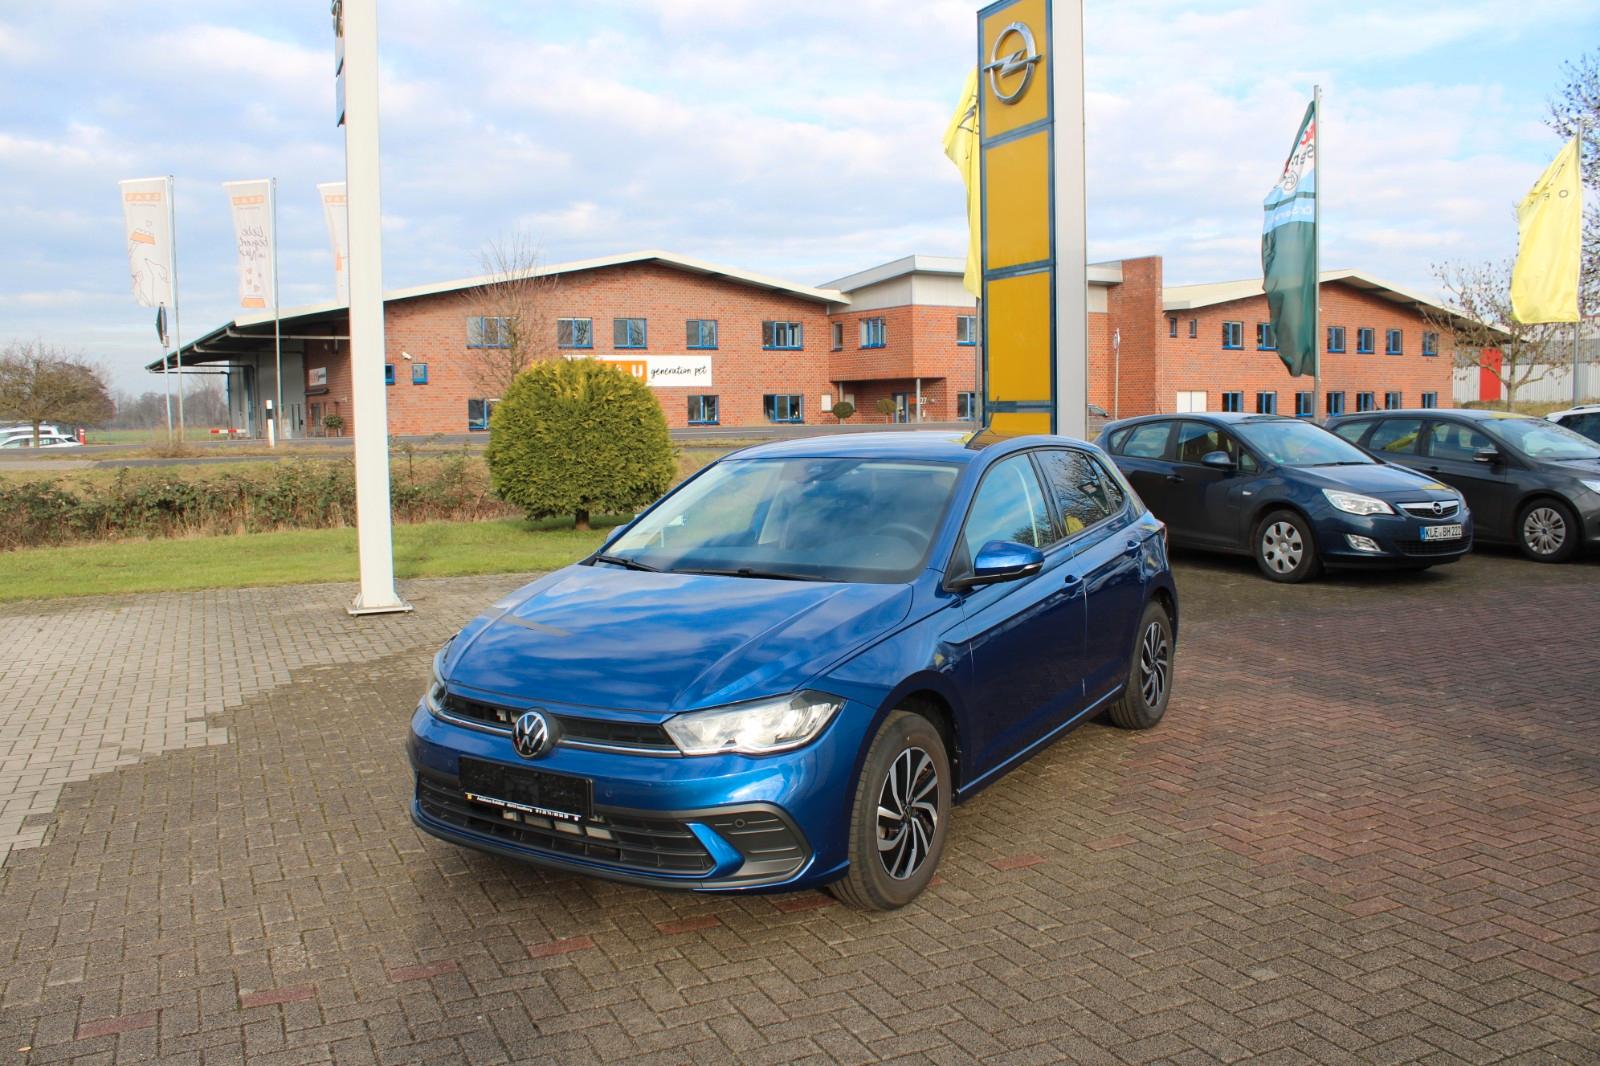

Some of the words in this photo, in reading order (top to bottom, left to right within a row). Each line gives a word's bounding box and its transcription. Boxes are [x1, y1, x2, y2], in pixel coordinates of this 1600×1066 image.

[651, 365, 691, 380] generation
[694, 365, 707, 377] pet
[1425, 527, 1439, 538] KLE
